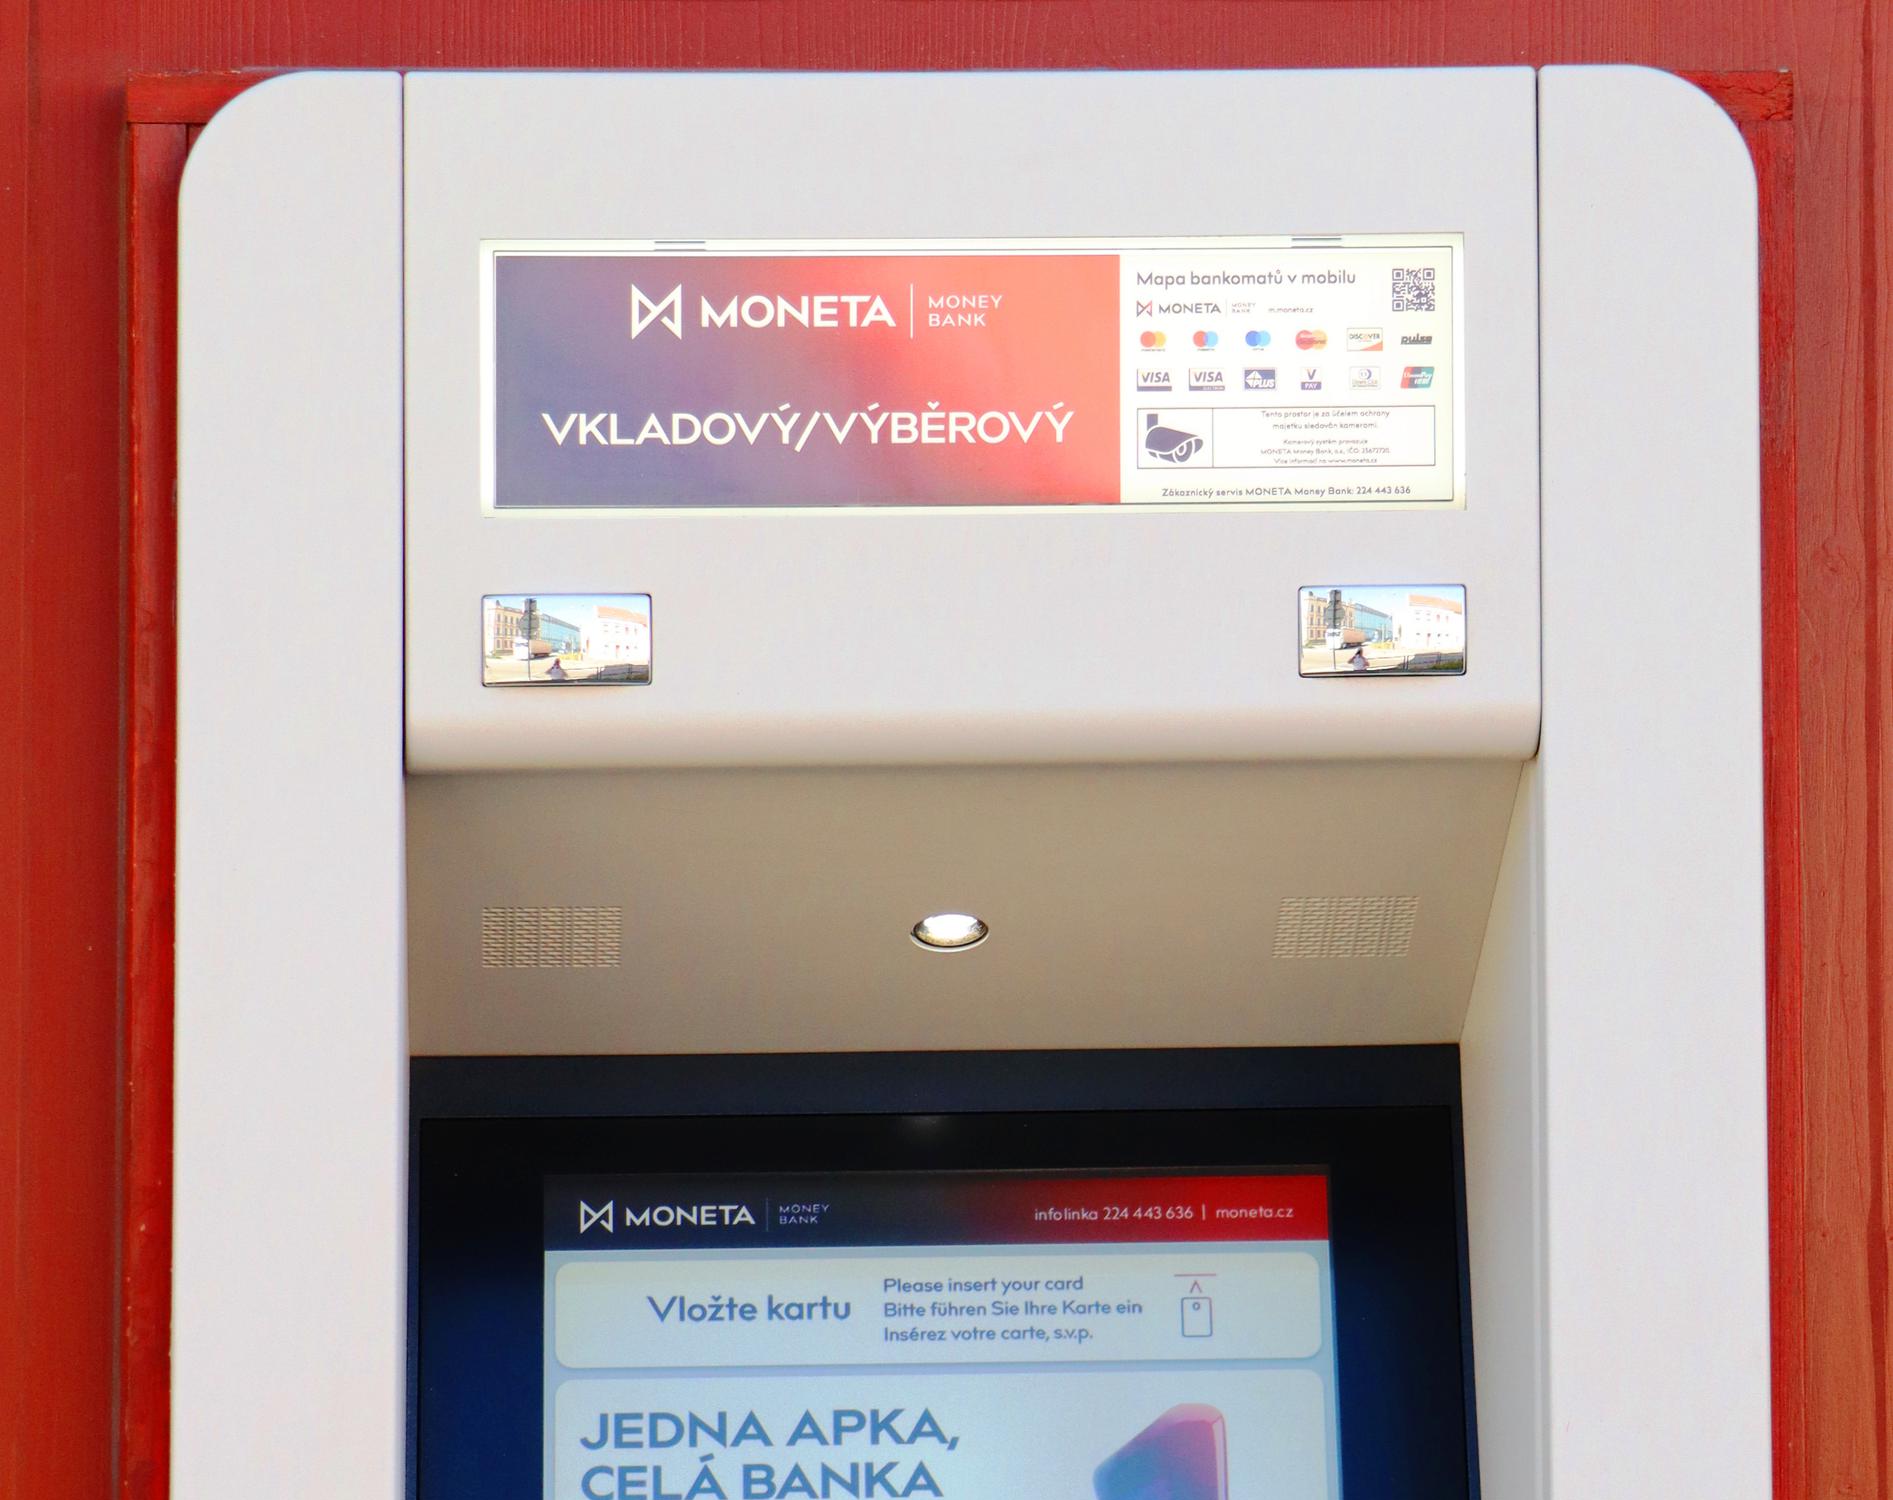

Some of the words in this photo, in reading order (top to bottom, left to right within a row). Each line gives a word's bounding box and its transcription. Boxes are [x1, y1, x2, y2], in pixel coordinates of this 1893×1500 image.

[1136, 272, 1186, 290] Mapa
[1190, 269, 1283, 286] bankomatů
[1287, 274, 1297, 284] v
[1301, 270, 1356, 285] mobilu
[928, 295, 1003, 310] MONEY
[1158, 302, 1222, 314] MONETA
[700, 295, 897, 328] MONETA
[928, 313, 987, 327] BANK
[1141, 371, 1171, 383] VISA
[1194, 371, 1223, 382] VISA
[1306, 368, 1317, 380] V
[541, 401, 1074, 452] VKLADOVÝ/VÝBĚROVÝ
[1161, 487, 1214, 498] Zákaznický
[1216, 488, 1243, 496] servis
[1245, 487, 1292, 496] MONETA
[1294, 487, 1325, 497] Money
[1356, 486, 1372, 494] 224
[1375, 486, 1392, 494] 443
[1394, 485, 1411, 494] 636
[625, 1204, 756, 1227] MONETA
[779, 1203, 830, 1214] MONEY
[1034, 1206, 1098, 1221] infolinka
[1103, 1206, 1129, 1220] 224
[1132, 1206, 1163, 1219] 443
[1165, 1205, 1194, 1219] 636
[1215, 1206, 1294, 1219] moneta.cz
[779, 1215, 819, 1225] BANK
[884, 1278, 943, 1293] Please
[948, 1277, 997, 1292] insert
[1001, 1280, 1040, 1295] your
[1044, 1276, 1083, 1291] card
[647, 1295, 758, 1323] Vložte
[767, 1294, 851, 1321] kartu
[884, 1302, 926, 1318] Bitte
[930, 1301, 986, 1317] führen
[991, 1301, 1019, 1316] Sie
[1024, 1301, 1058, 1315] Ihre
[1062, 1301, 1111, 1315] Karte
[1115, 1301, 1142, 1314] ein
[884, 1326, 946, 1342] Insérez
[950, 1327, 995, 1341] votre
[1001, 1326, 1050, 1342] carte,
[1054, 1328, 1093, 1344] s.v.p.
[579, 1410, 773, 1450] JEDNA
[786, 1408, 960, 1451] APKA,
[742, 1460, 944, 1500] BANKA
